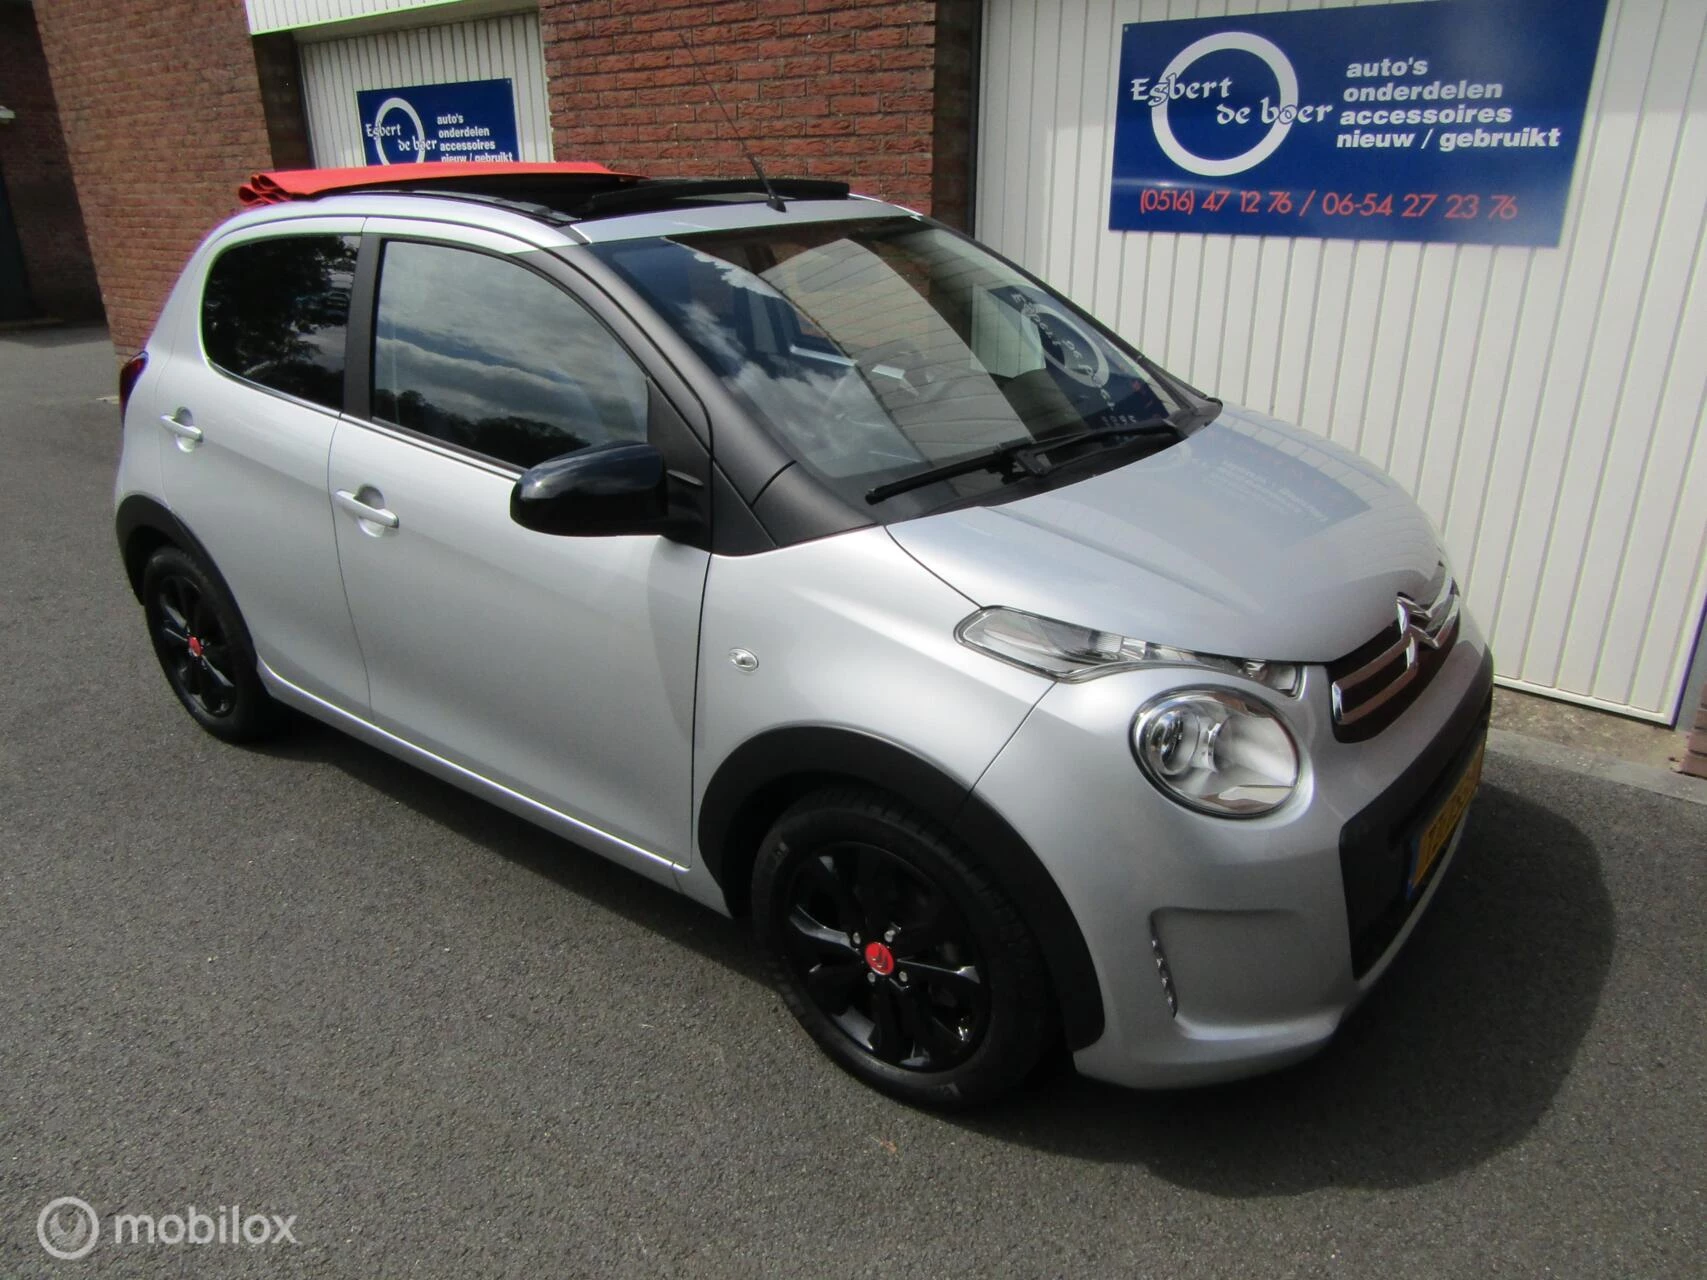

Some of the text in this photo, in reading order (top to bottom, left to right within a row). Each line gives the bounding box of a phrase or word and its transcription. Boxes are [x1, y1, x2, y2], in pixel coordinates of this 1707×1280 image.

[1346, 57, 1428, 78] auto's
[1343, 80, 1503, 102] onderdelen
[437, 113, 464, 125] auto's
[1216, 97, 1333, 125] de boer
[1339, 104, 1513, 125] accessoires
[438, 126, 490, 138] onderdelen
[1336, 127, 1561, 152] nieuw / gebruikt
[440, 139, 496, 151] accessoires
[1140, 189, 1518, 220] (0516) 47 12 76 / 06-54 27 23 76
